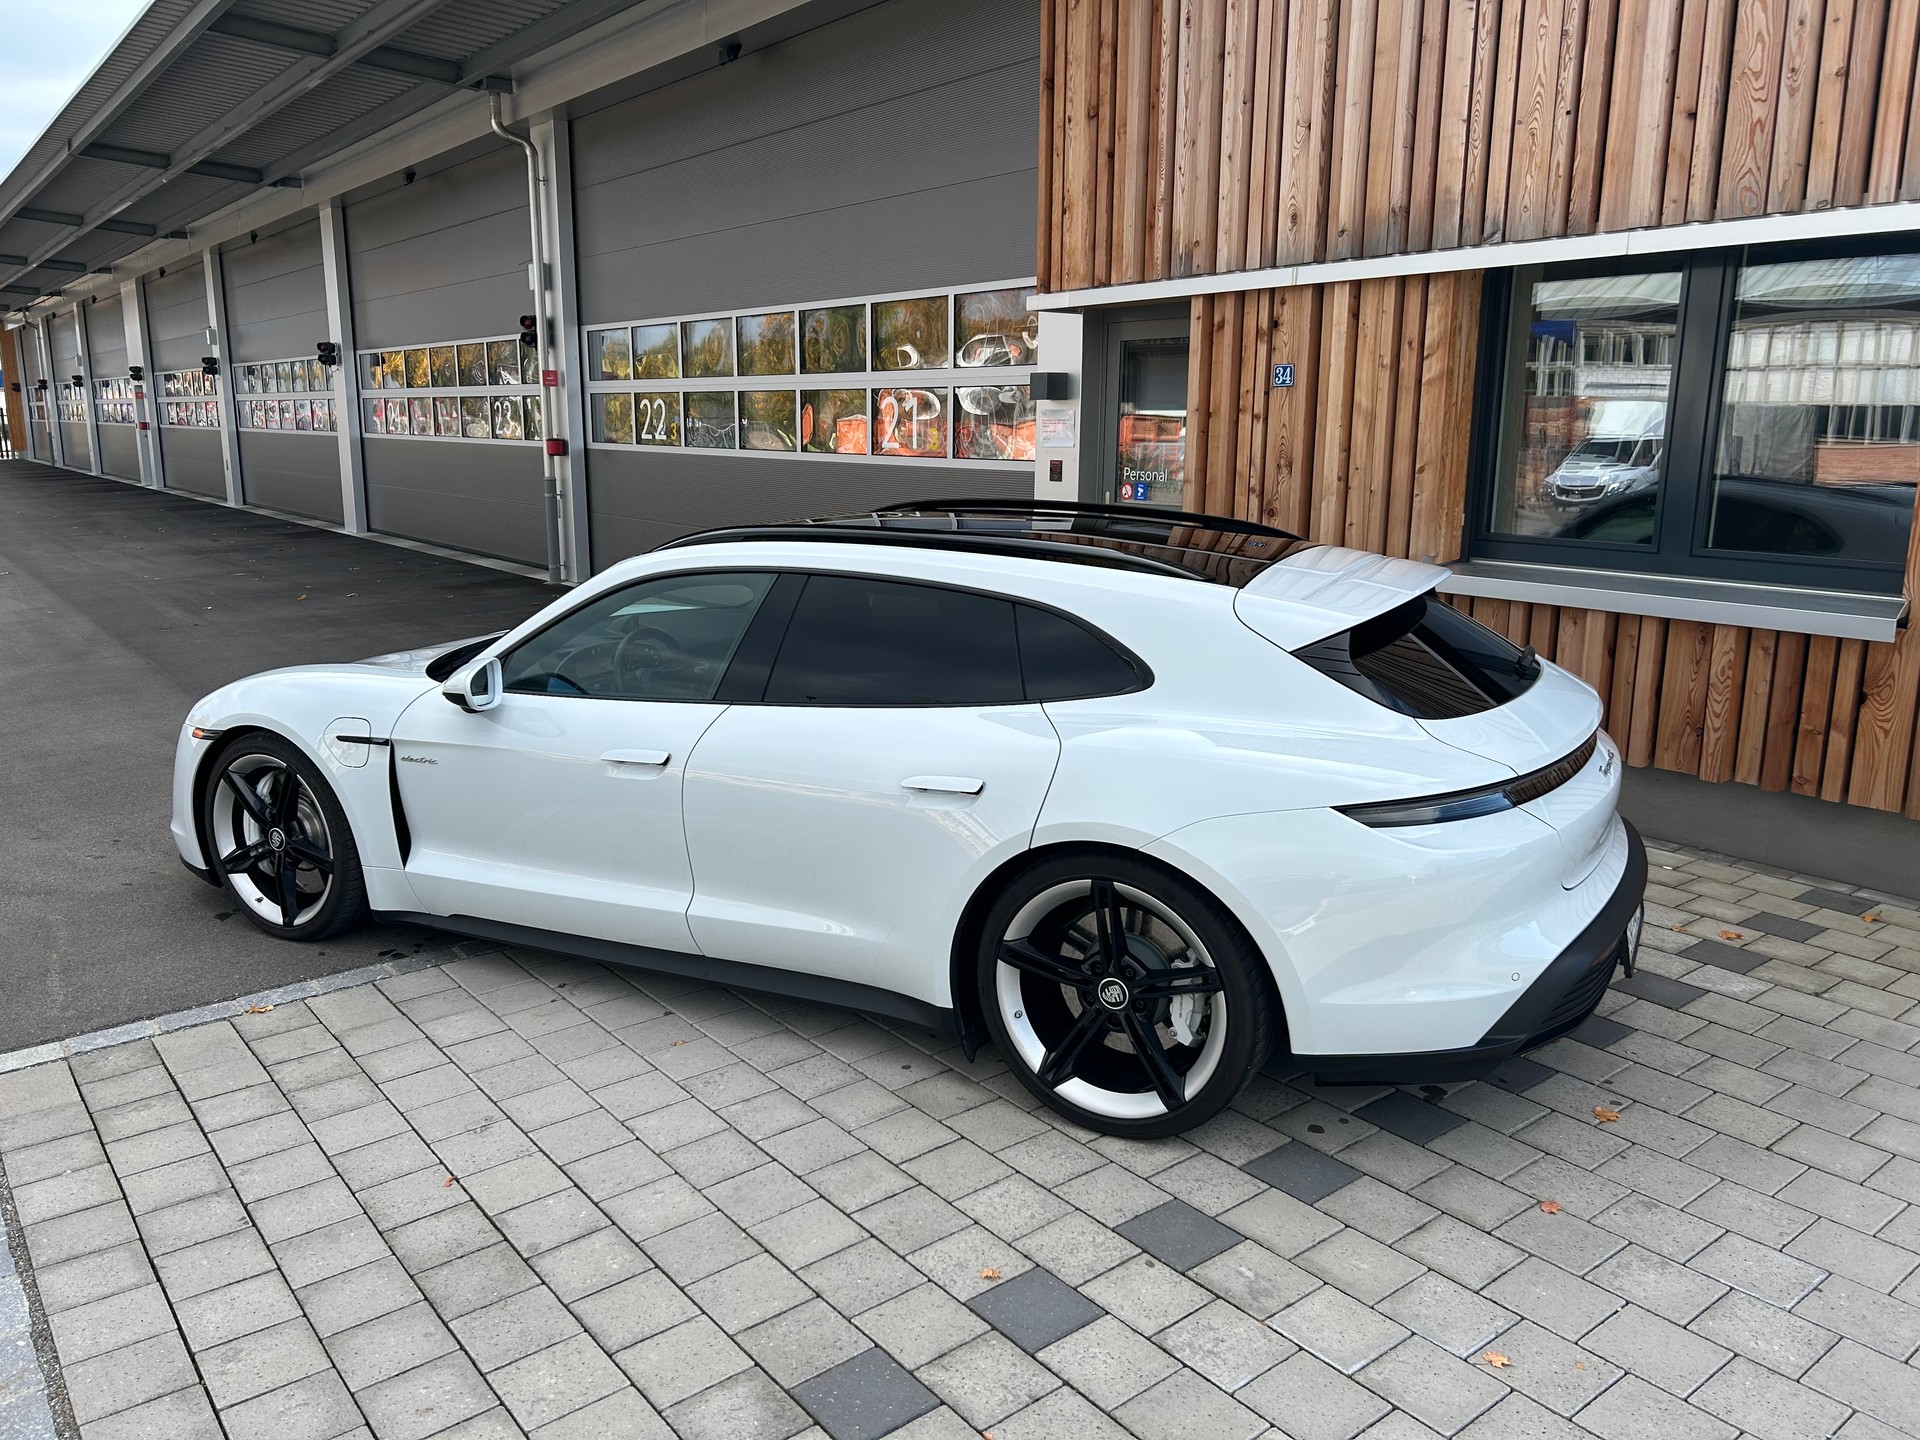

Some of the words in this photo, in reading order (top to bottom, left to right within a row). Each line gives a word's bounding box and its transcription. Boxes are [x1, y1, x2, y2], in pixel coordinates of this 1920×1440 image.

[1275, 366, 1292, 384] 34
[494, 401, 513, 434] 23
[640, 399, 667, 440] 22
[880, 396, 918, 450] 21
[671, 422, 678, 440] 3
[928, 426, 939, 450] 3
[1124, 467, 1168, 482] Personal
